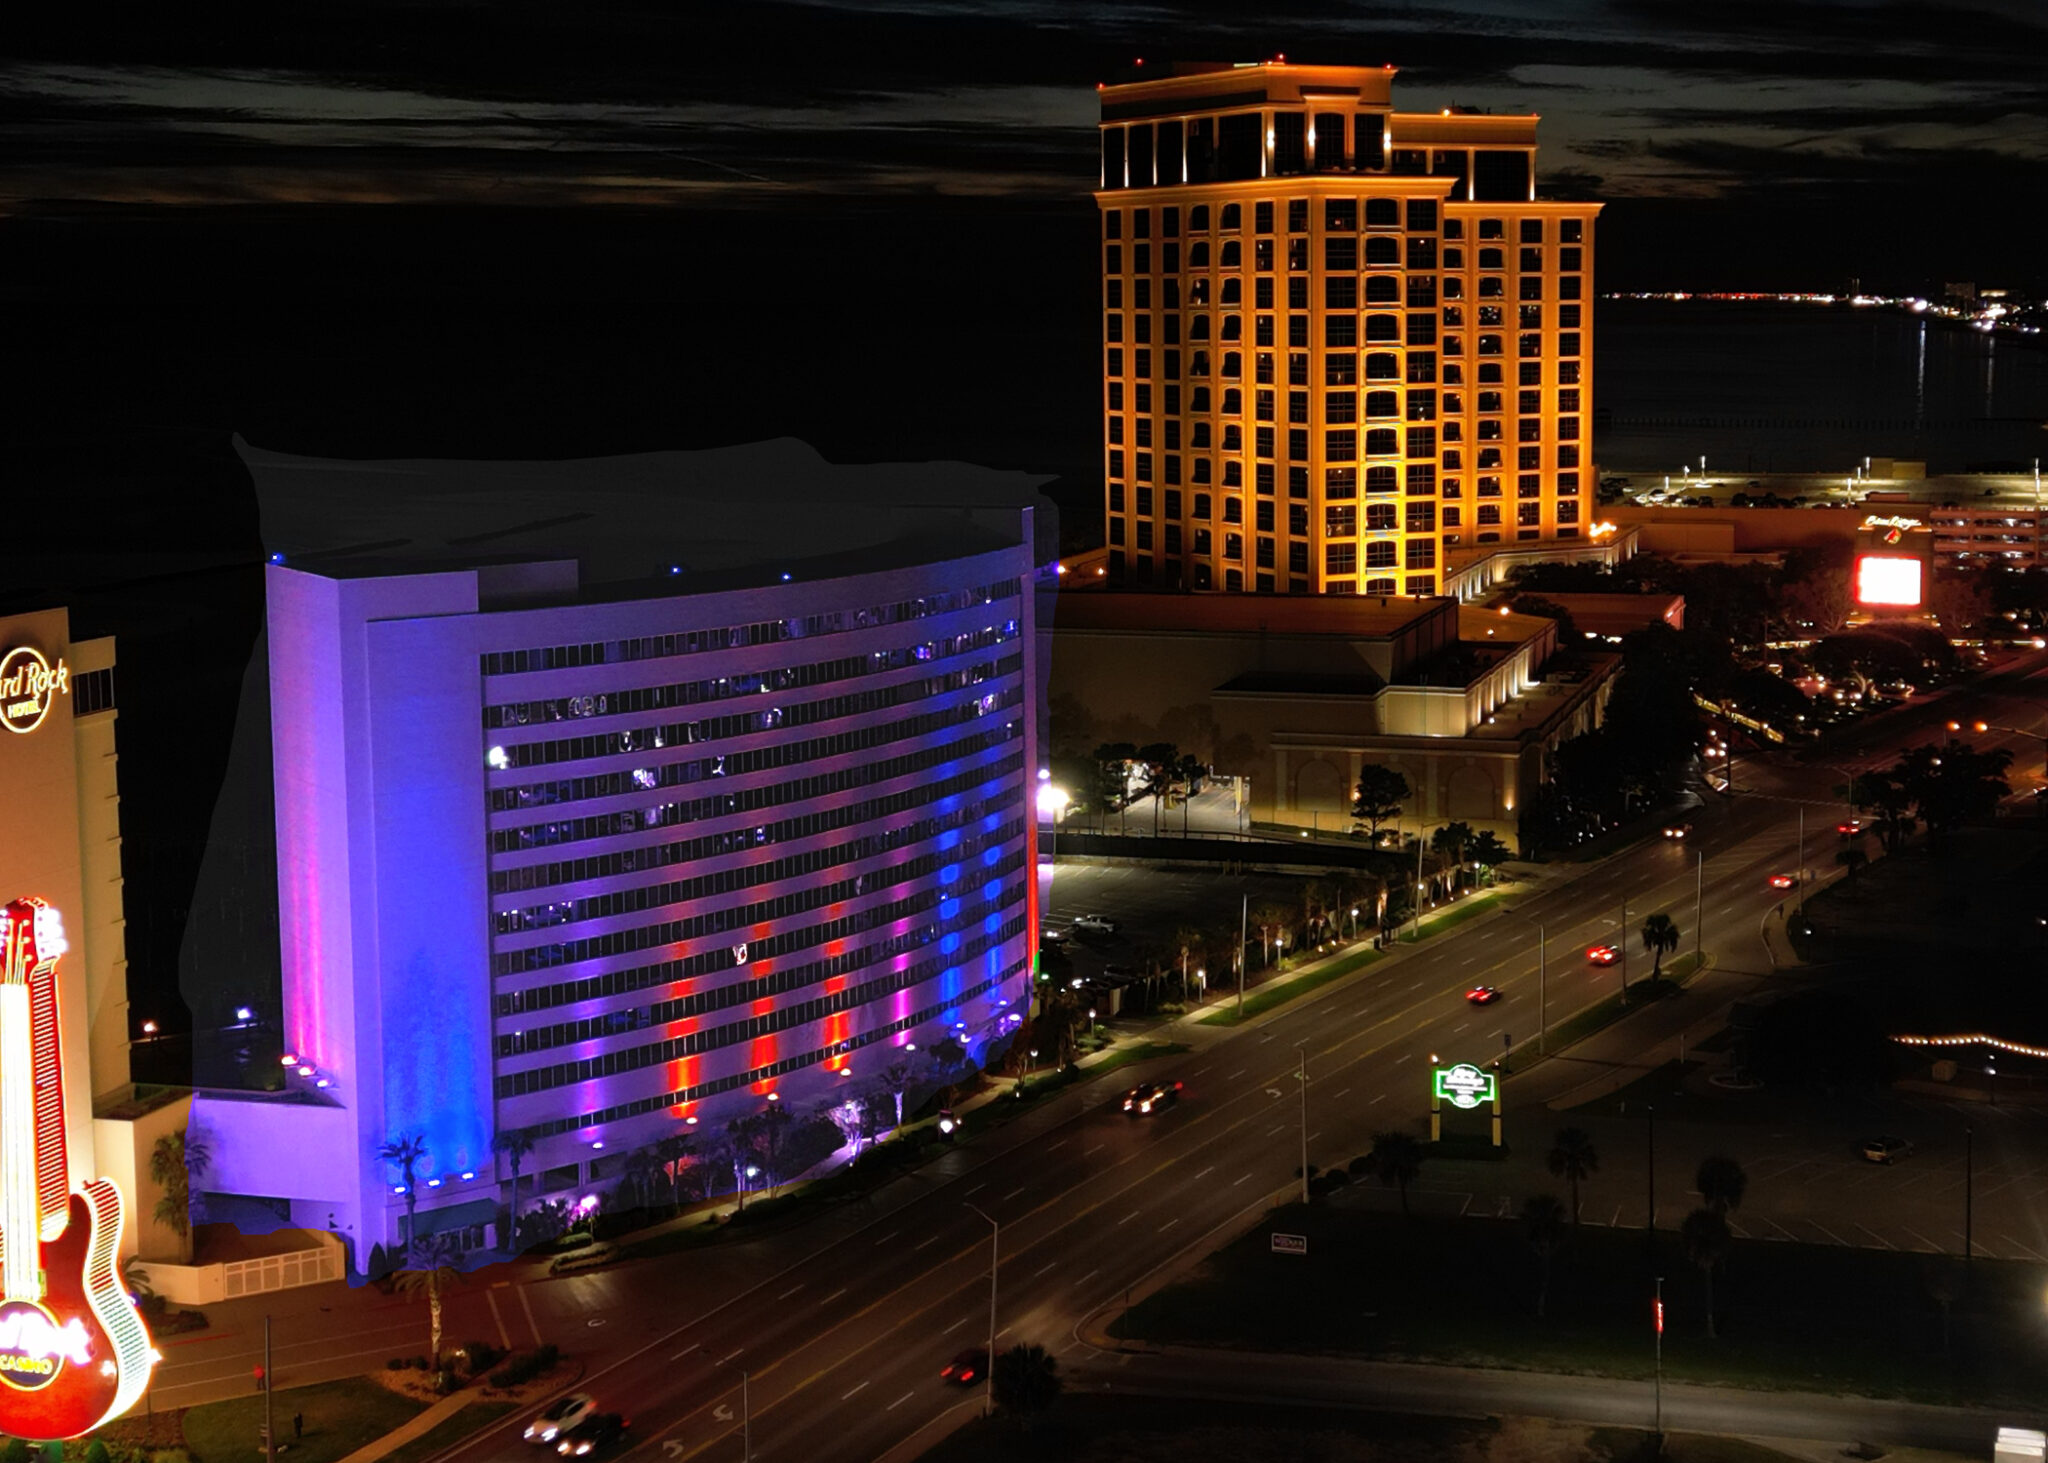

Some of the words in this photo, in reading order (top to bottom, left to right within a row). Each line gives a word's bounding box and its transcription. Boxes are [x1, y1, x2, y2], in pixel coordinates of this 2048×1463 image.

[24, 658, 69, 699] Rock
[8, 700, 41, 719] HOTEL
[0, 1354, 53, 1375] CASINO
